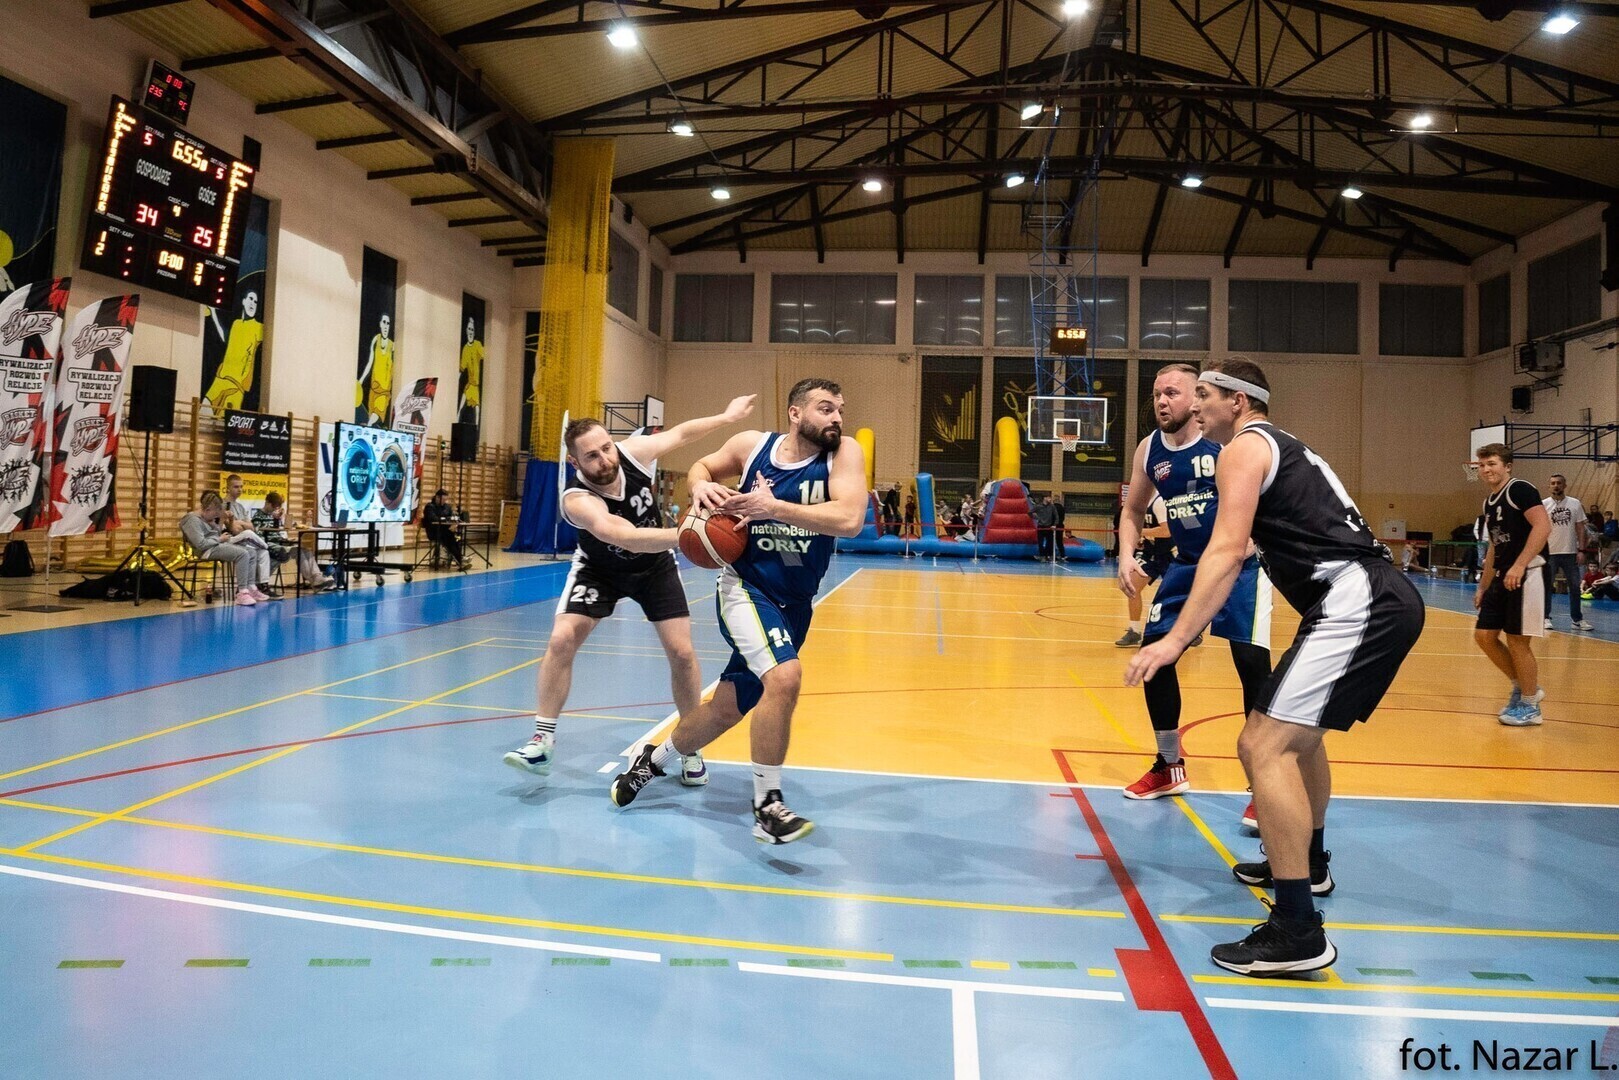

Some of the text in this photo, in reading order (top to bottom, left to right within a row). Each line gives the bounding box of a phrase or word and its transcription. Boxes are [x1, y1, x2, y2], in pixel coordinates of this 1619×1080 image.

[144, 132, 153, 145] 5
[136, 158, 172, 187] GOSPODARZE
[216, 167, 224, 179] 5
[136, 203, 159, 227] 34
[193, 226, 213, 248] 25
[159, 250, 184, 271] 0:00
[1, 308, 58, 346] HYPE
[72, 323, 127, 359] HYPE
[7, 380, 42, 390] RELACJE
[80, 391, 112, 400] RELACJE
[227, 415, 255, 429] SPORT
[1191, 454, 1215, 478] 19
[629, 487, 653, 516] 23
[798, 480, 826, 504] 14
[1169, 502, 1208, 520] ORŁY
[1497, 505, 1503, 521] 2
[751, 524, 820, 536] naturoBan
[756, 537, 812, 553] ORŁY
[570, 584, 599, 604] 23
[1146, 603, 1162, 623] 19
[768, 627, 793, 648] 14
